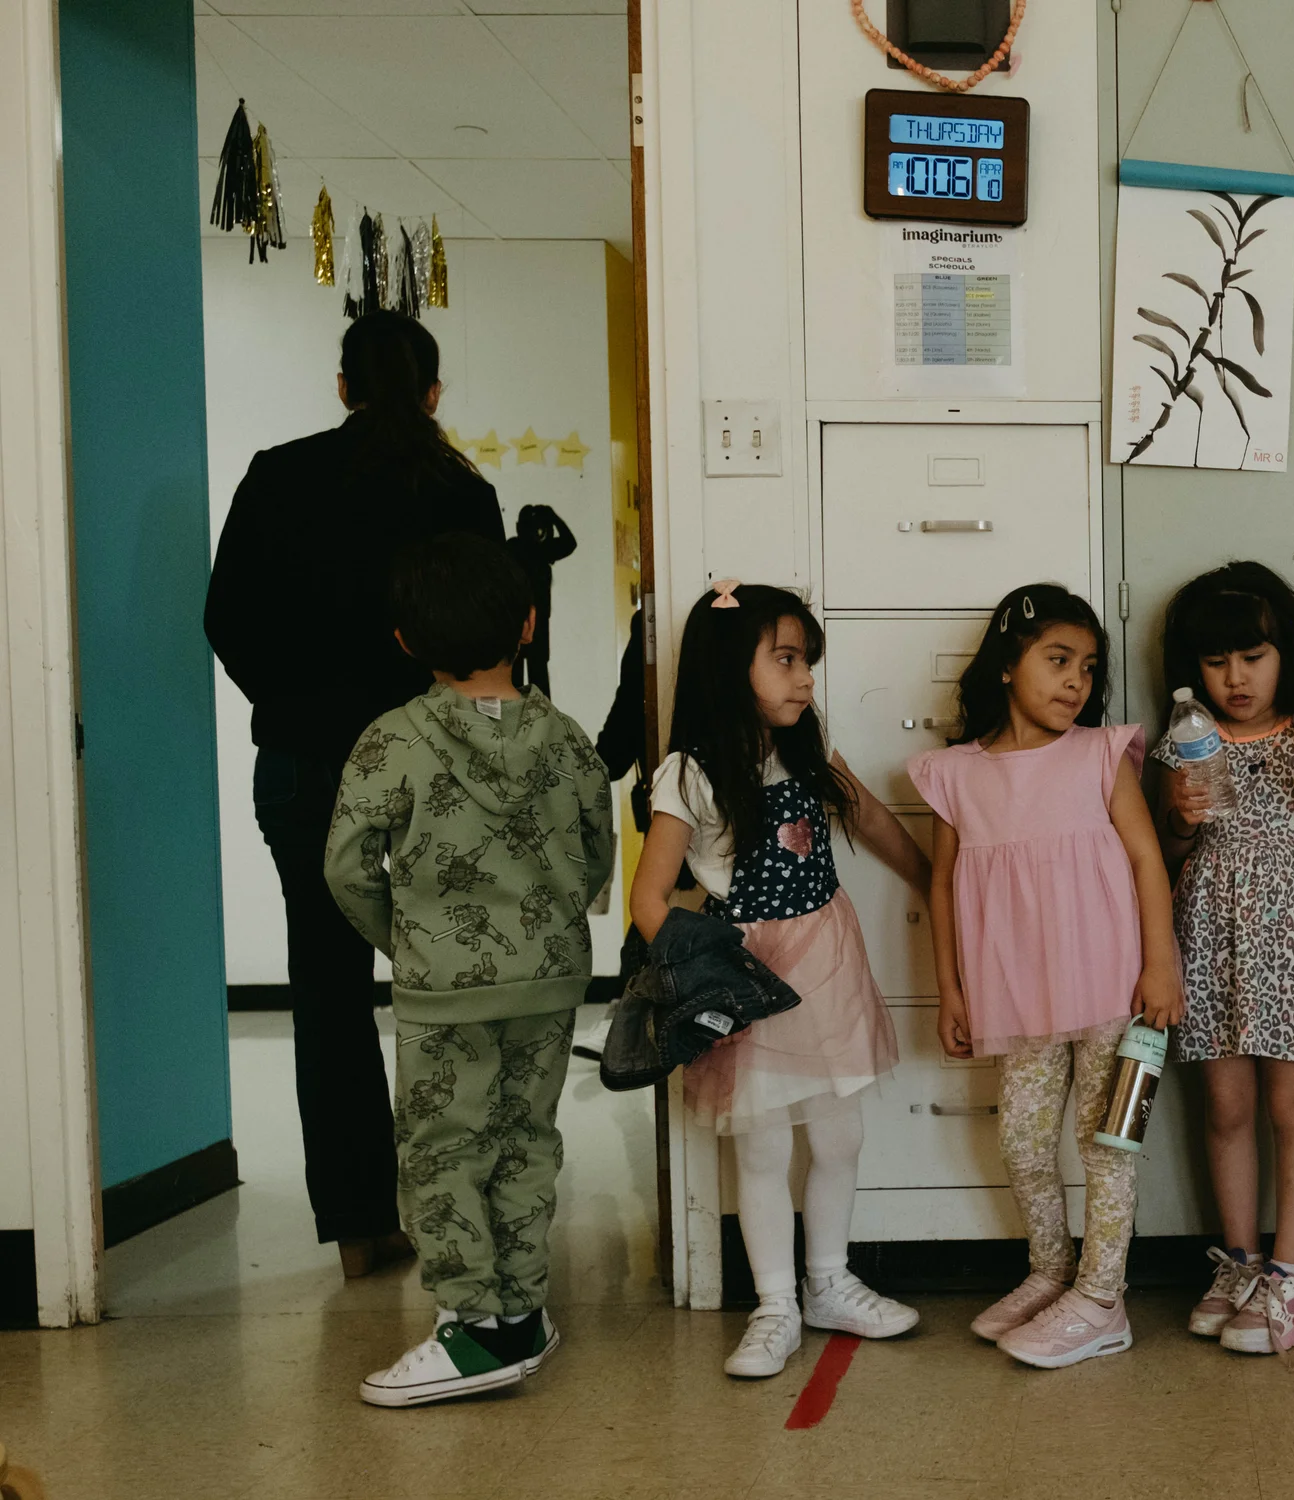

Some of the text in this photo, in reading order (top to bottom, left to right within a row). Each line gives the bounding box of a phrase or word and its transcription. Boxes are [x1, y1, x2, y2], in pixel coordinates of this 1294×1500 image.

[906, 119, 1002, 144] THURSDAY
[892, 160, 904, 169] AM
[979, 163, 1002, 175] APR
[987, 179, 1000, 199] 10
[902, 228, 1003, 244] imaginarium
[1253, 452, 1284, 463] MR Q
